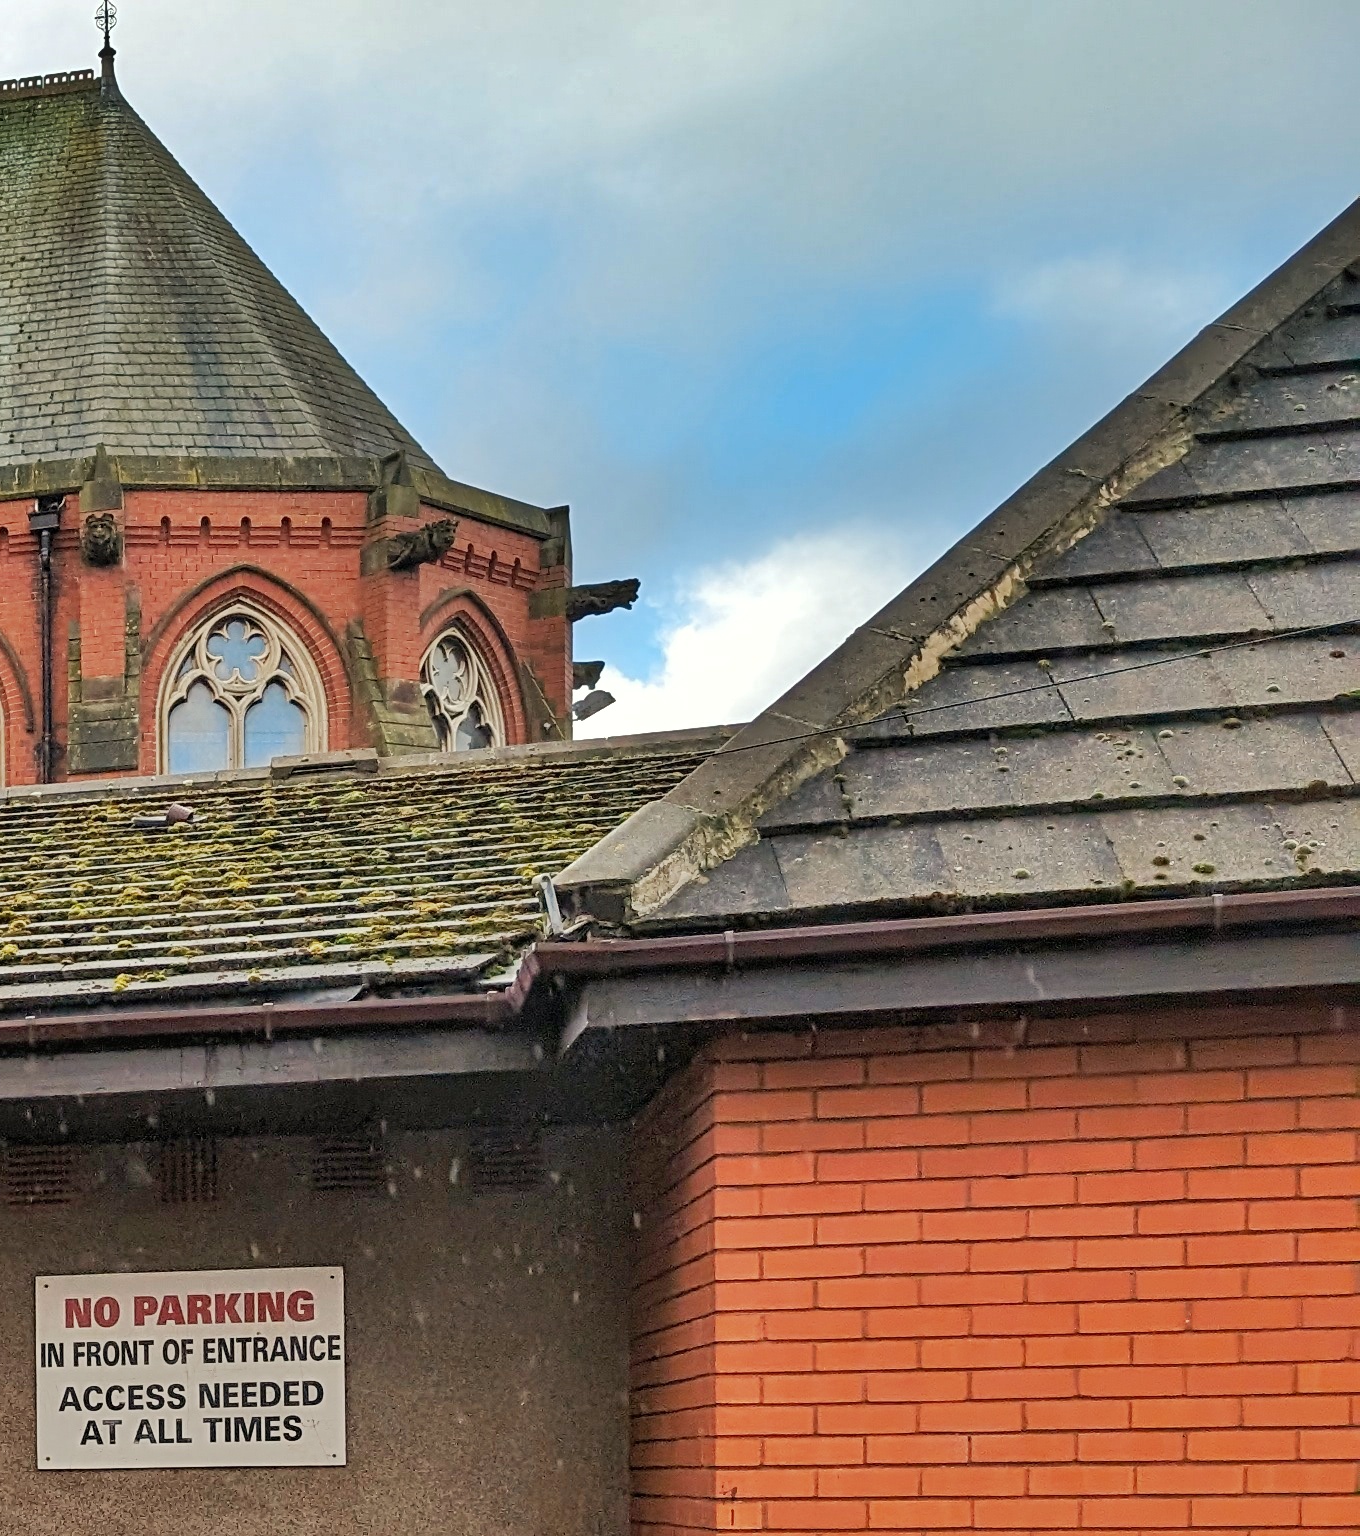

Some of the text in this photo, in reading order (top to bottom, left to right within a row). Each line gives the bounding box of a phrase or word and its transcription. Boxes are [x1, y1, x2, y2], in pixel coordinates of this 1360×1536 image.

[64, 1290, 315, 1329] NO PARKING
[40, 1334, 341, 1368] IN FRONT OF ENTRANCE
[59, 1380, 324, 1412] ACCESS NEEDED
[80, 1415, 303, 1445] AT ALL TIMES
